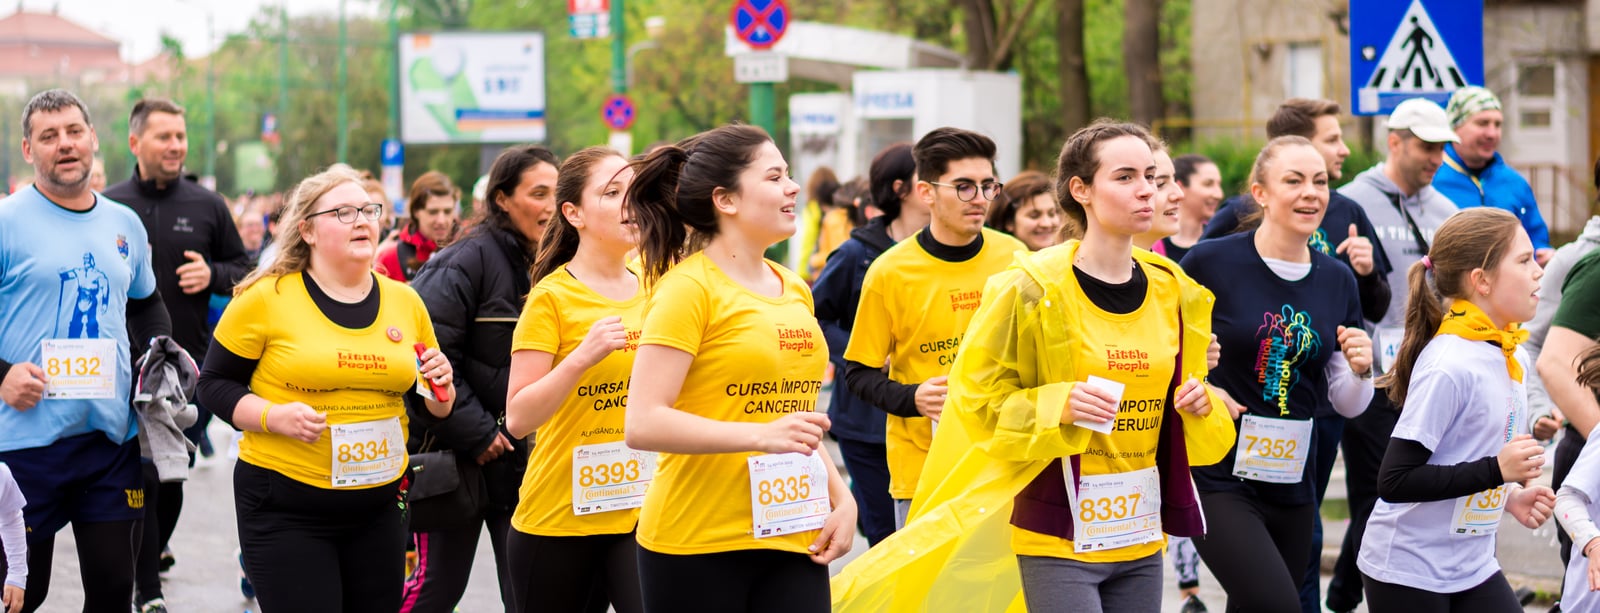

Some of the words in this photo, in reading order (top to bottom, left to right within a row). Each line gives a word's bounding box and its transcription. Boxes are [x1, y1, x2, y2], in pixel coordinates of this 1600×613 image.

[777, 328, 812, 339] Little
[779, 340, 813, 352] People
[920, 337, 959, 354] CURSA
[337, 352, 385, 362] Little
[1106, 349, 1148, 360] Little
[1258, 337, 1273, 383] TIMOTION
[47, 357, 101, 377] 8132
[337, 361, 387, 371] People
[1107, 361, 1150, 373] People
[577, 381, 624, 397] CURSA
[726, 382, 778, 396] CURSA
[1278, 360, 1291, 416] TIMOTION
[1119, 399, 1165, 413] MPOTR
[337, 438, 389, 463] 8334
[1244, 435, 1297, 459] 7352
[579, 459, 640, 487] 8393
[585, 486, 630, 500] Continental
[758, 473, 811, 506] 8335
[765, 505, 802, 521] Continental
[1079, 492, 1142, 523] 8337
[1086, 523, 1131, 537] Continental
